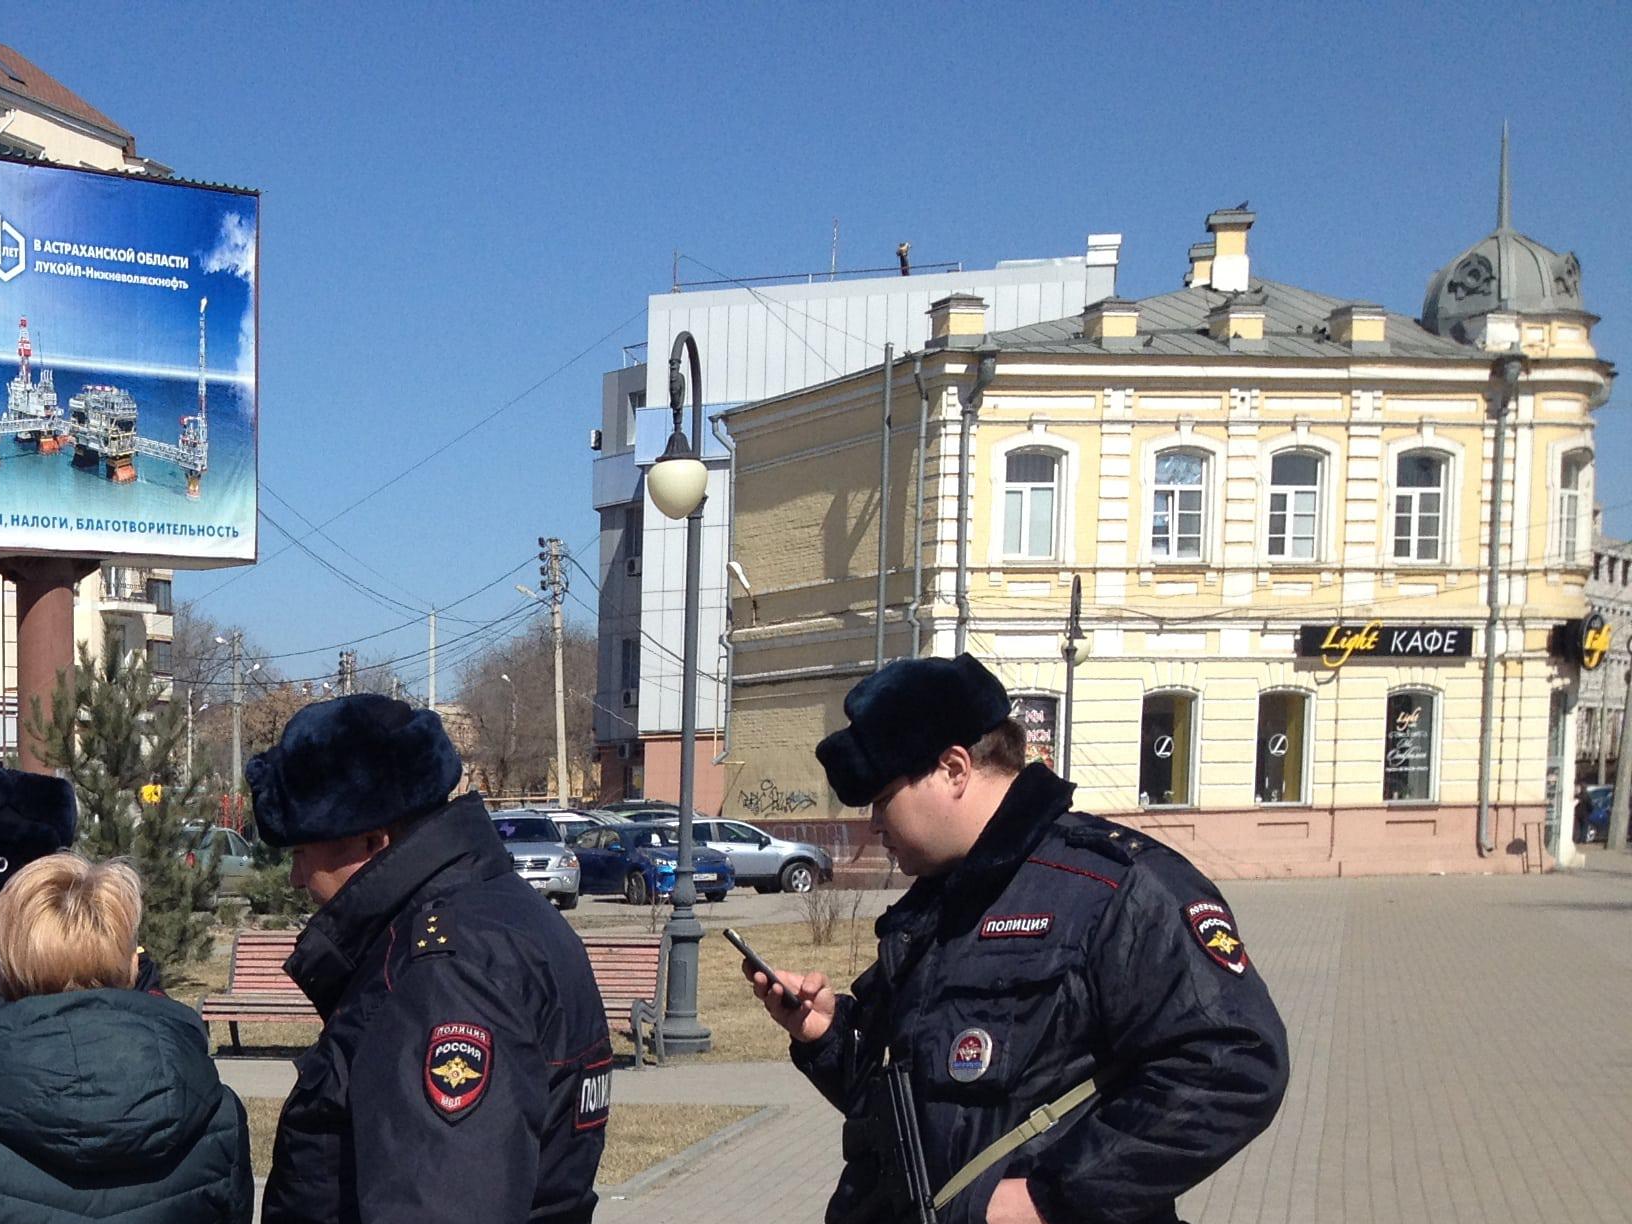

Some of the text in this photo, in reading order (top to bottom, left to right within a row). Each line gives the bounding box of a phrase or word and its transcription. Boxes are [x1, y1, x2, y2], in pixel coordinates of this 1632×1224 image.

[1, 245, 19, 259] ЛЕТ
[33, 238, 189, 270] В АСТРАХАНСКОЙ ОБЛАСТИ
[10, 514, 74, 532] НАЛОГИ,
[76, 517, 240, 539] БЛАГОТВОРИТЕЛЬНОСТЬ
[1321, 619, 1384, 668] Light
[1390, 630, 1459, 654] КАФЕ
[986, 918, 1049, 933] ПОЛИЦИЯ
[435, 1042, 482, 1062] РОССИЯ
